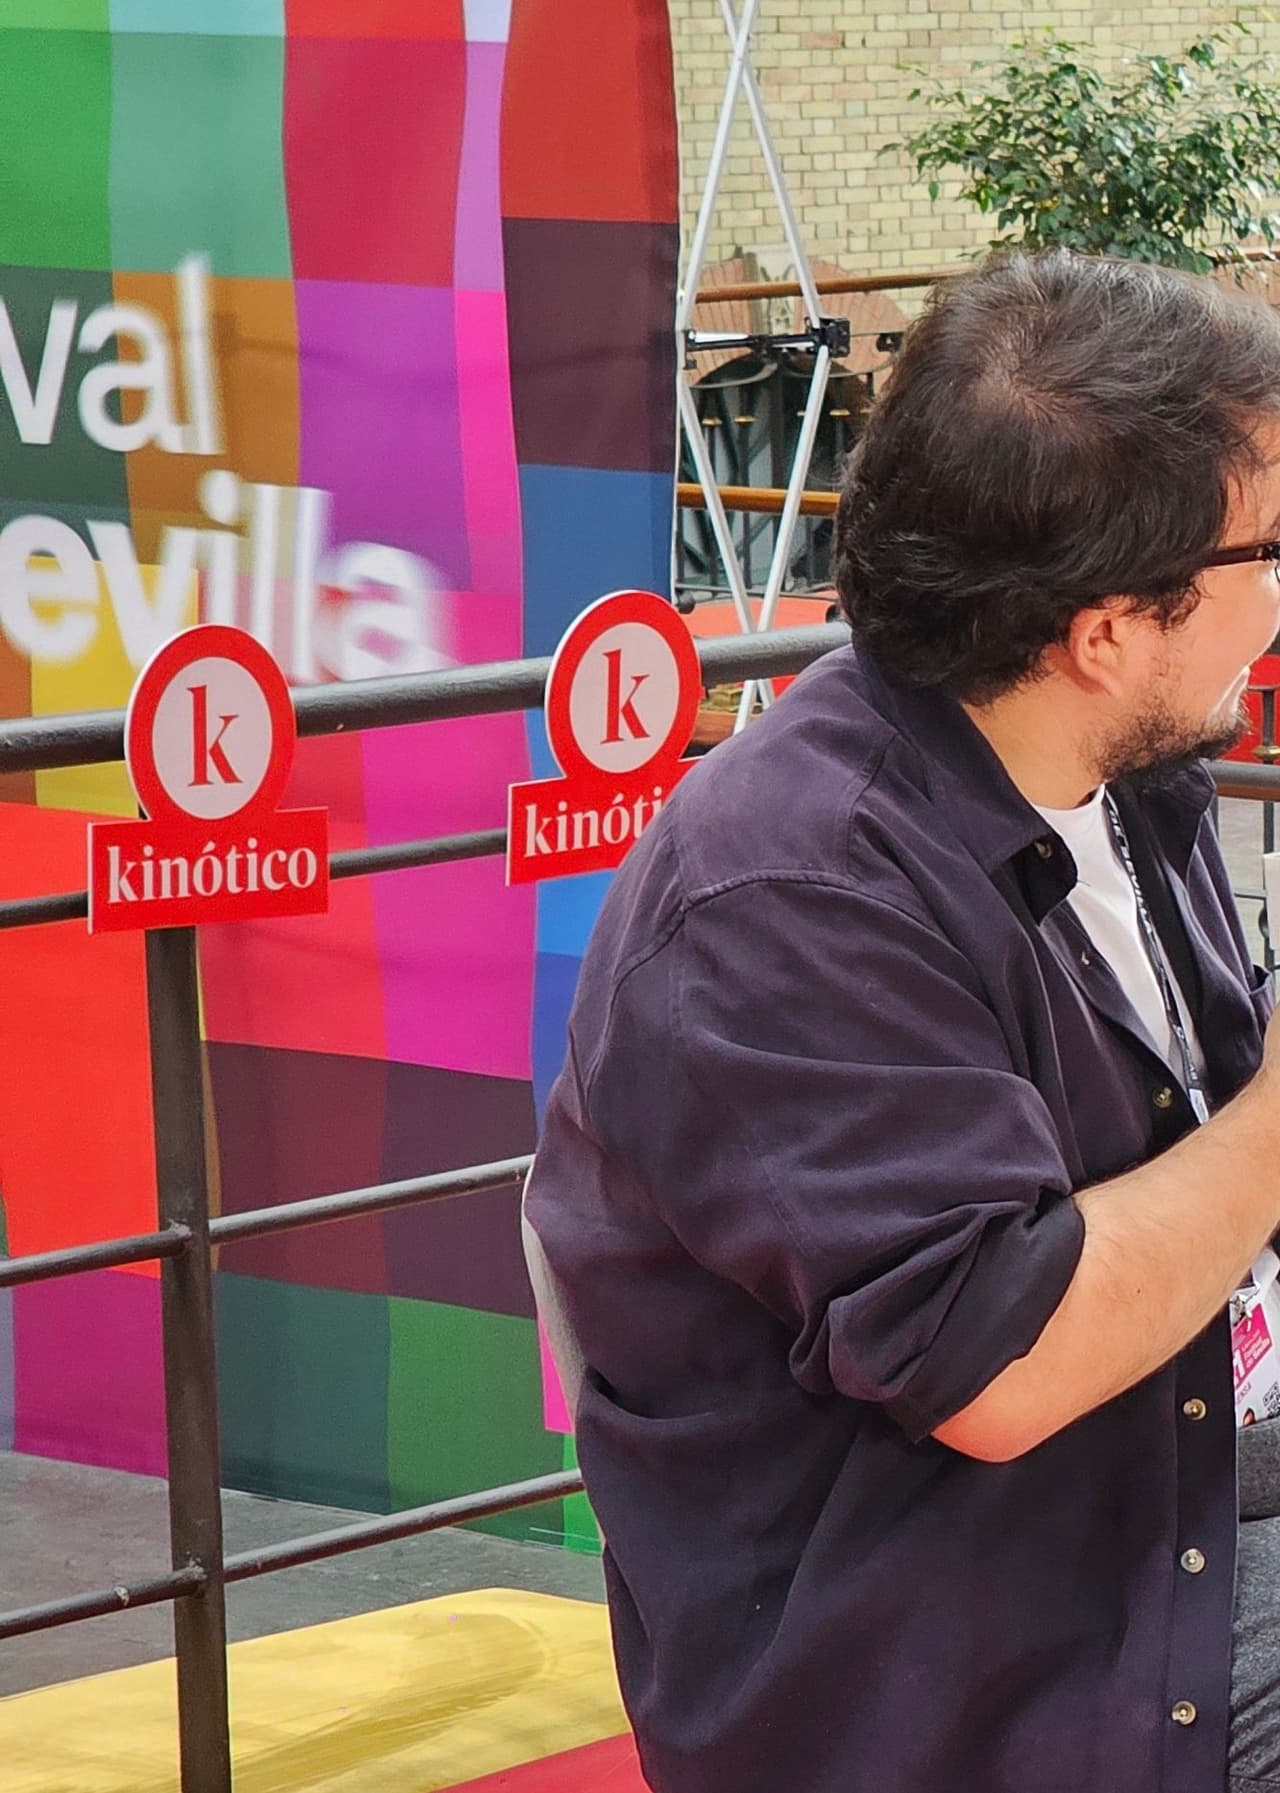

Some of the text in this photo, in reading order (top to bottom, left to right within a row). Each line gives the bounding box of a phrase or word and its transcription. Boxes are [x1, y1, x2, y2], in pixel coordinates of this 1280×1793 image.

[0, 250, 225, 457] val
[187, 685, 243, 787] k
[601, 648, 651, 745] k
[524, 785, 662, 858] kinóti
[107, 837, 318, 905] kinótico
